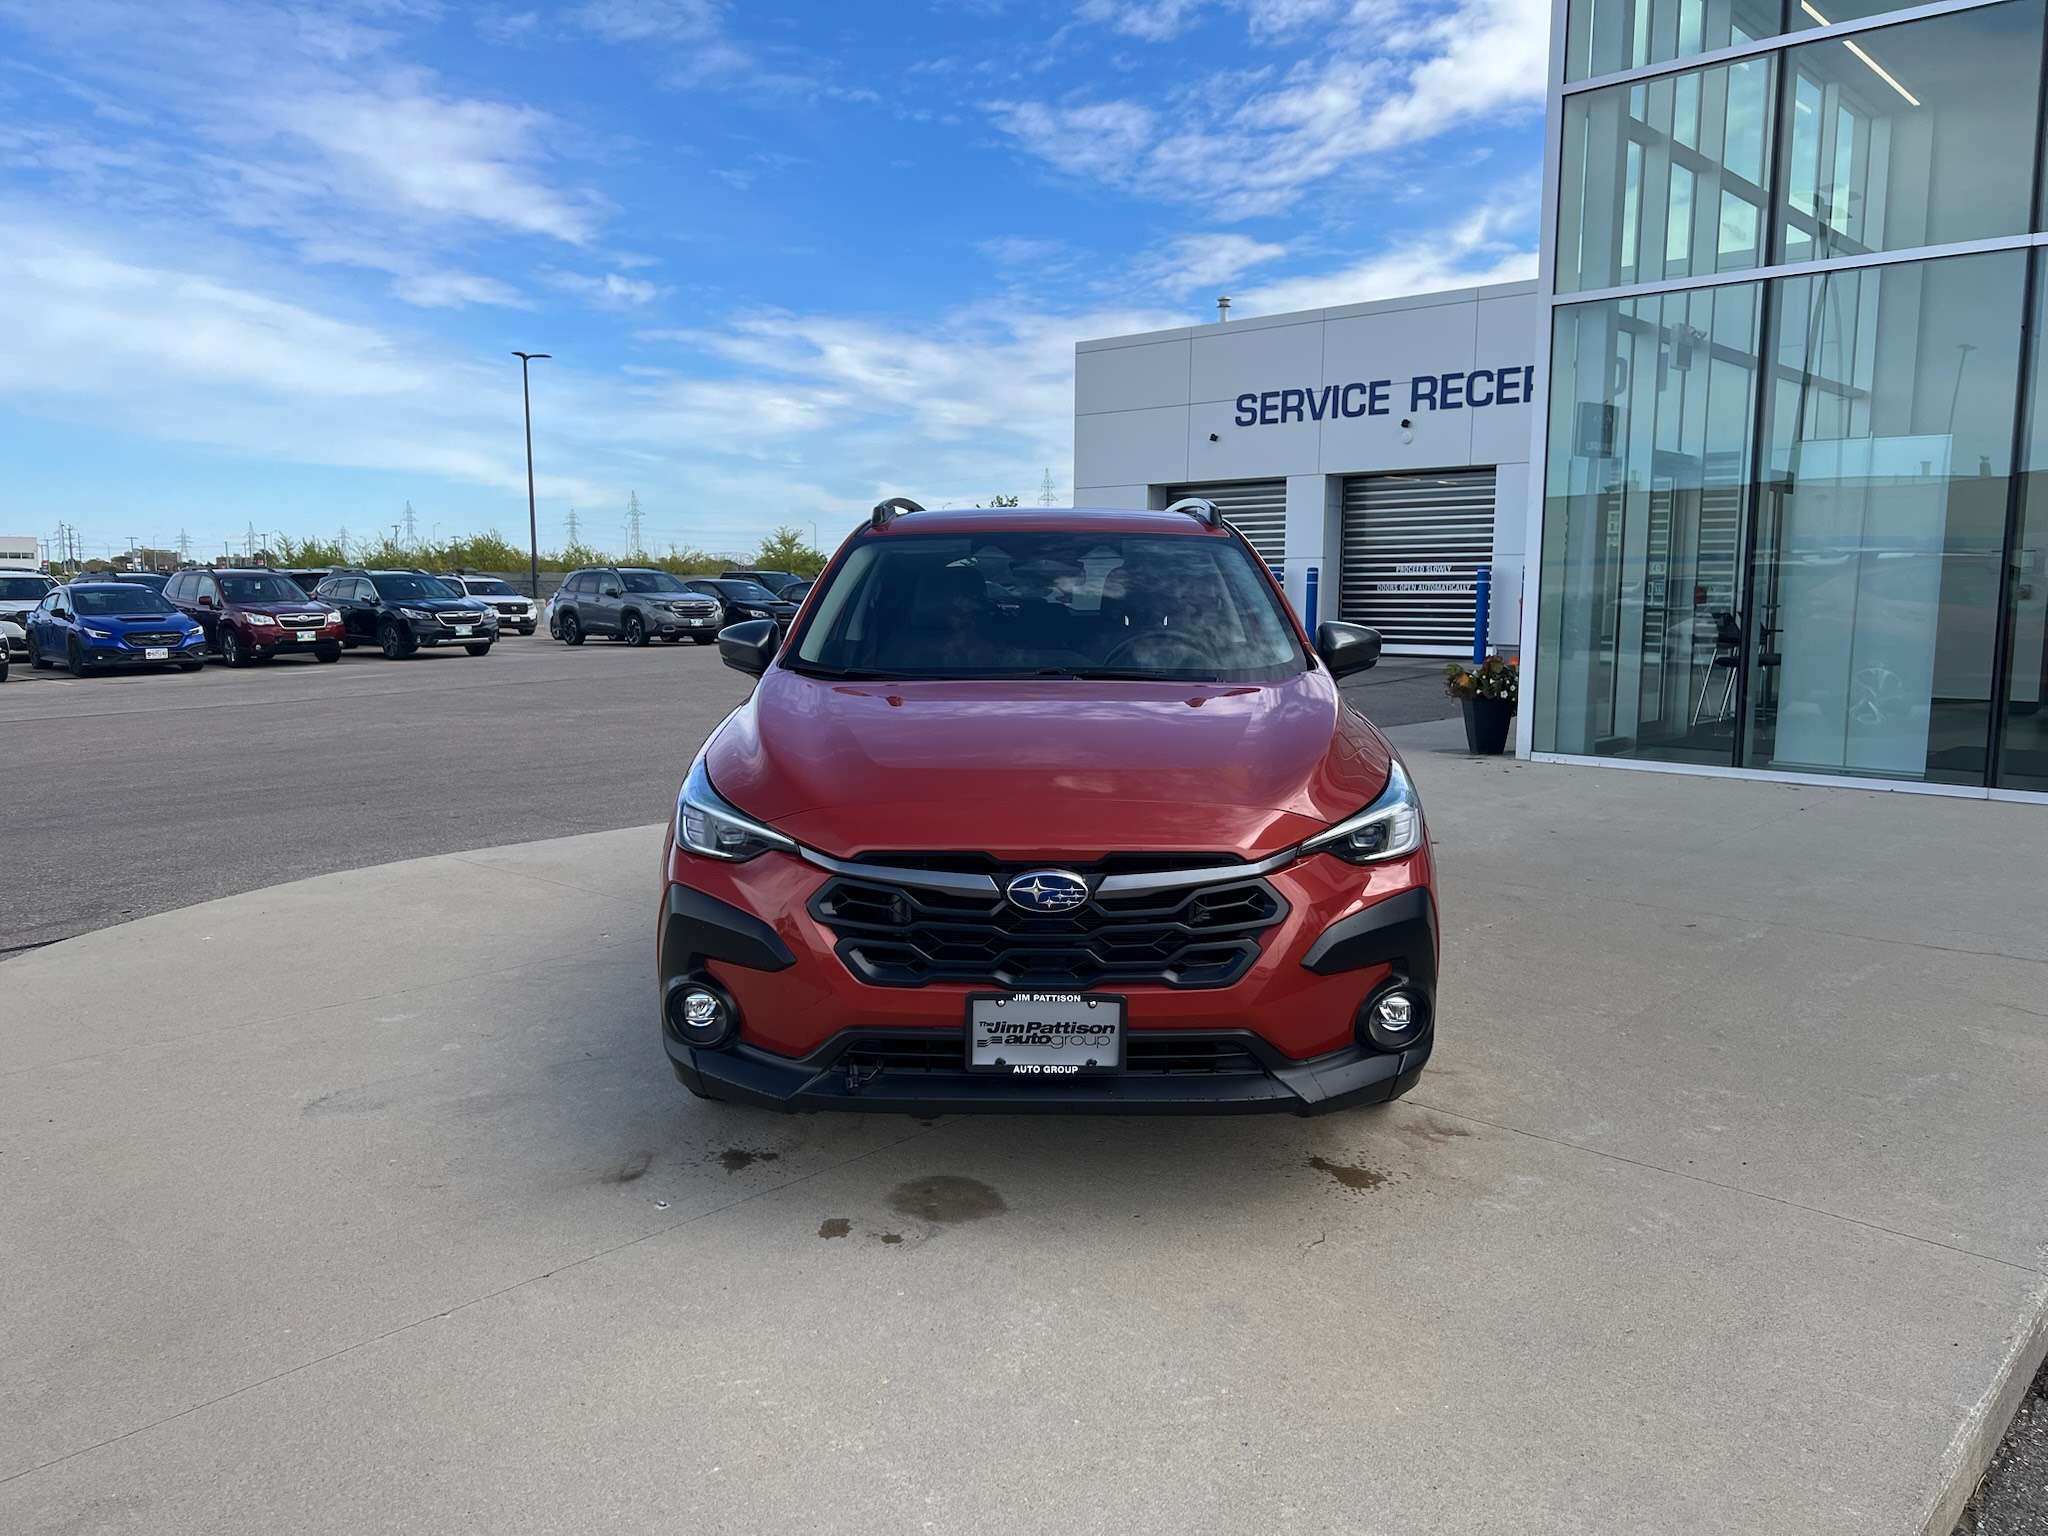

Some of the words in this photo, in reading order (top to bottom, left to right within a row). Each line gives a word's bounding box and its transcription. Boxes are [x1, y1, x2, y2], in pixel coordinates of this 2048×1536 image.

[1235, 380, 1391, 427] SERVICE
[1395, 564, 1425, 574] PROCEED
[1426, 564, 1452, 573] SLOWLY
[1376, 583, 1398, 592] DOORS
[1399, 583, 1416, 592] OPEN
[1418, 583, 1470, 592] AUTOMATICALLY
[1012, 993, 1030, 1002] JIM
[1033, 994, 1081, 1002] PATTISON
[987, 1021, 1025, 1034] Jim
[1026, 1021, 1115, 1034] Pattison
[1013, 1065, 1041, 1074] AUTO
[1043, 1065, 1079, 1074] GROUP
